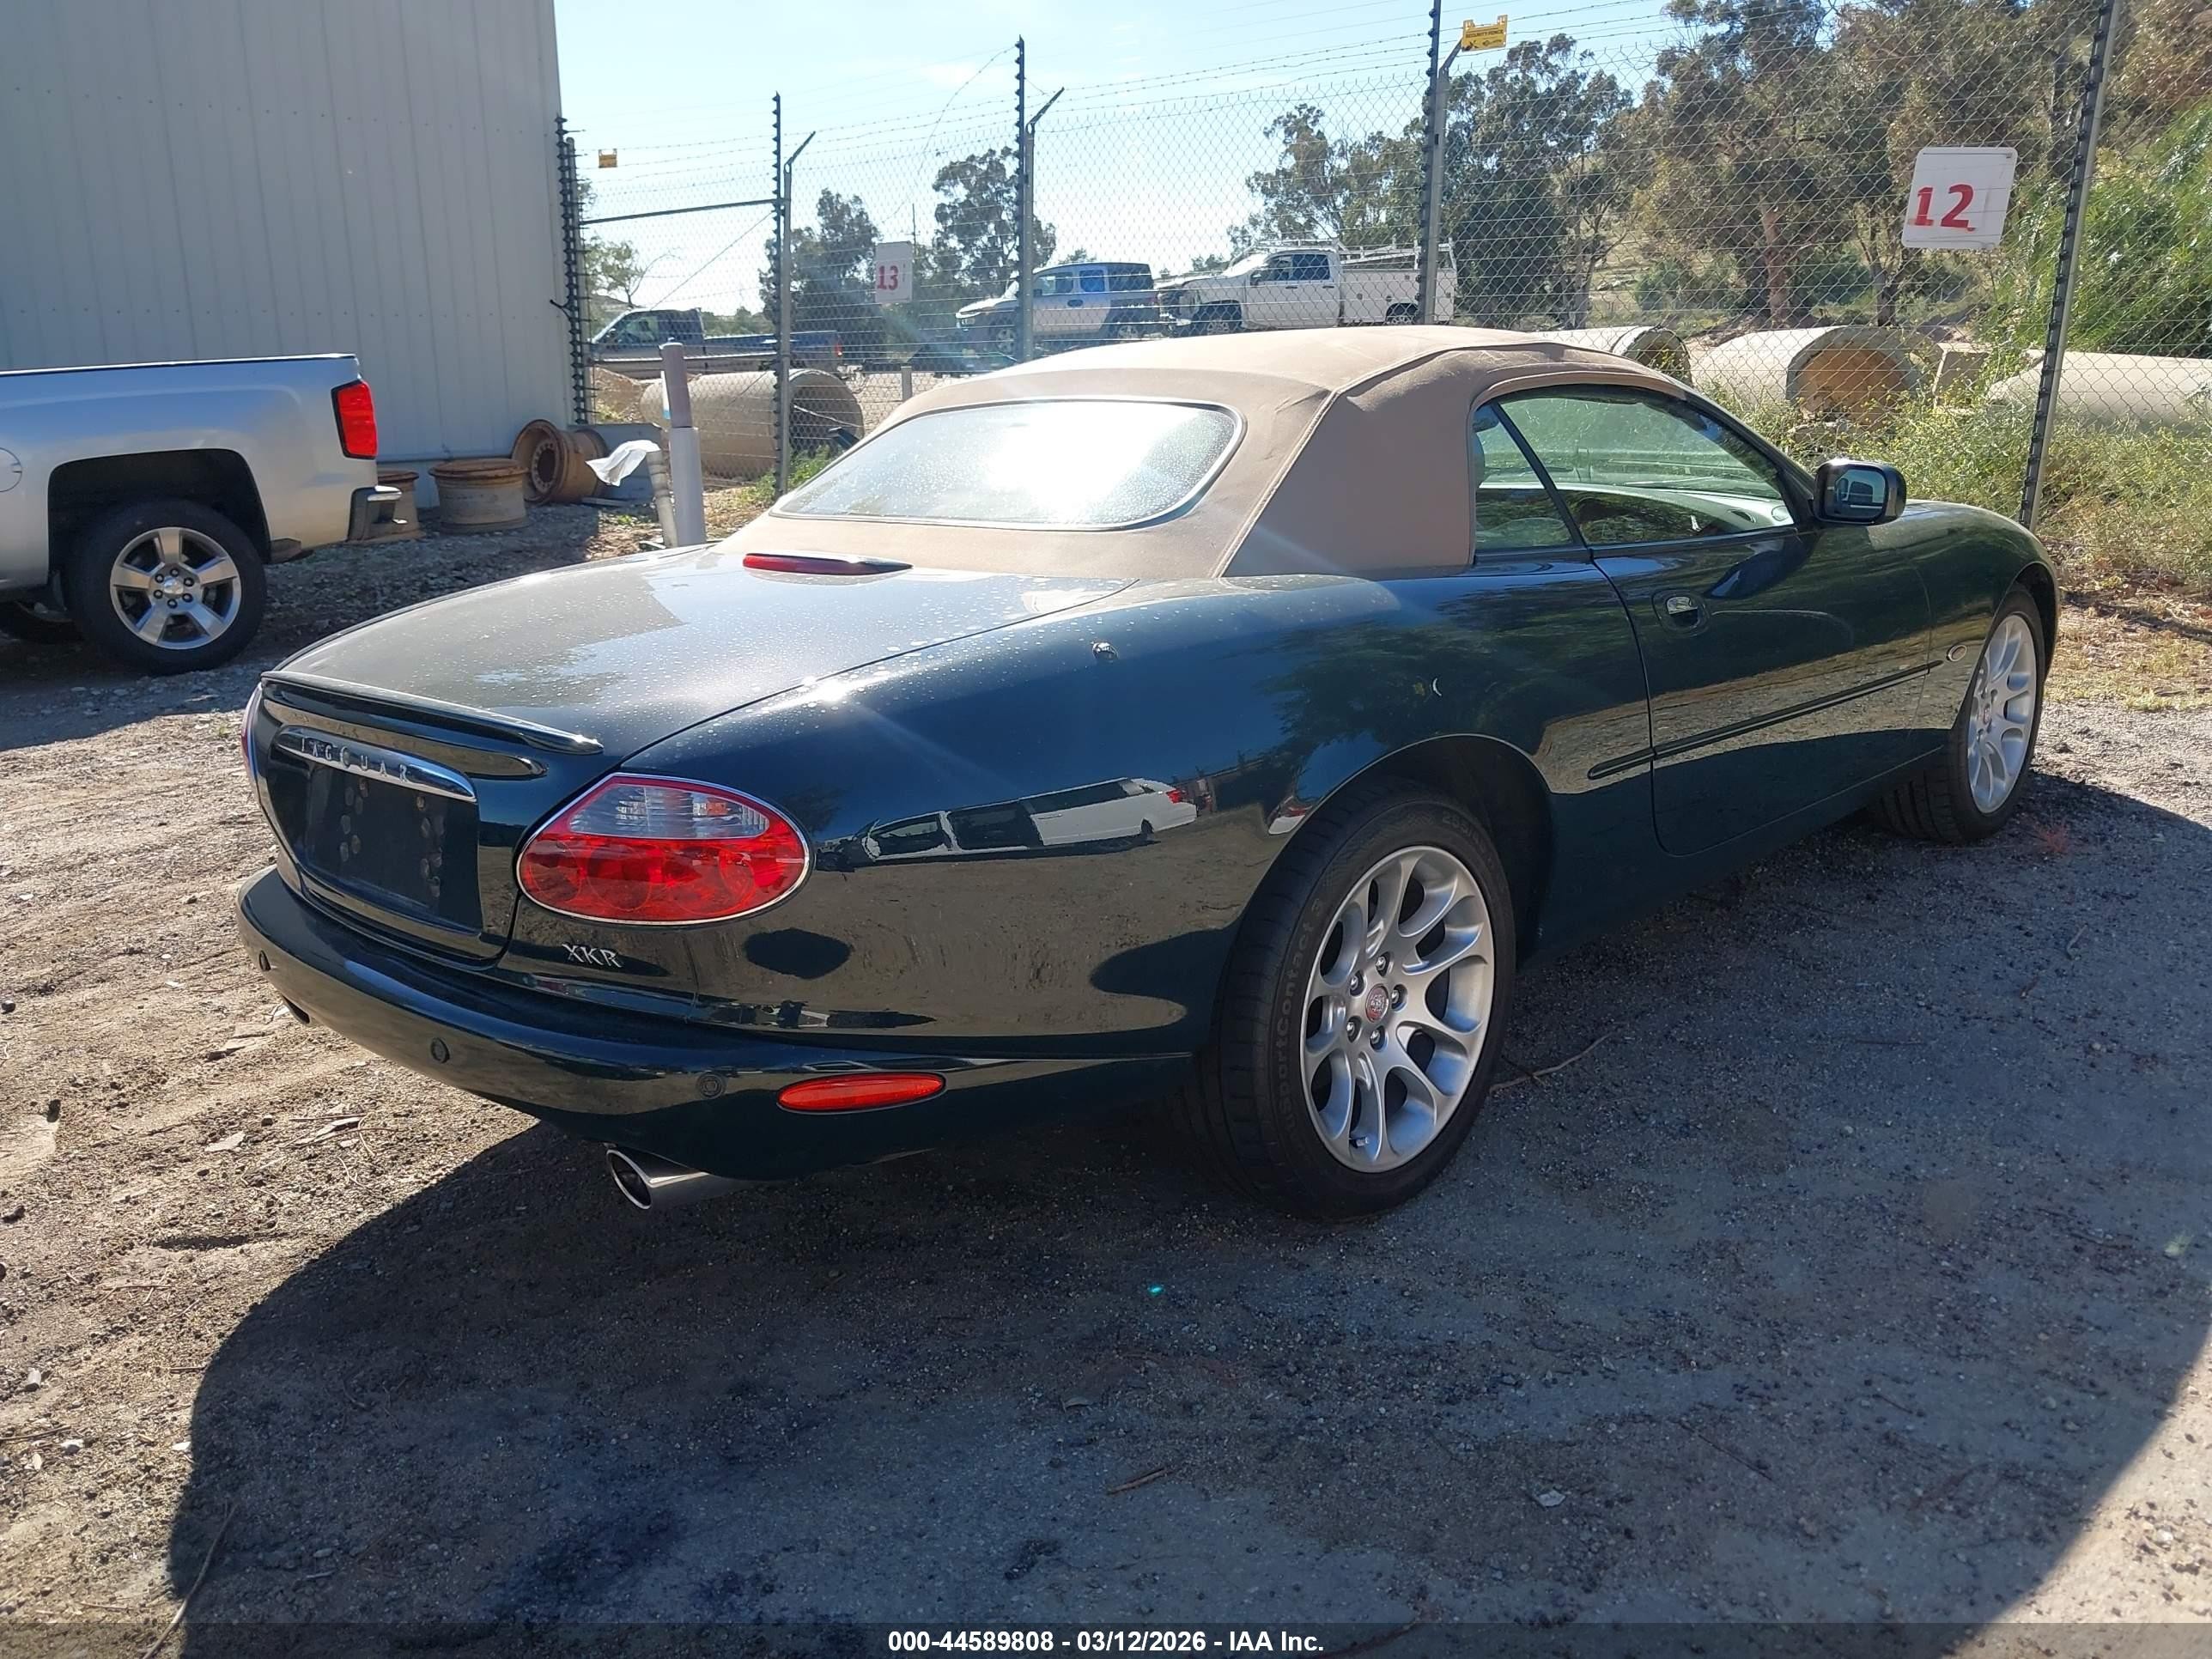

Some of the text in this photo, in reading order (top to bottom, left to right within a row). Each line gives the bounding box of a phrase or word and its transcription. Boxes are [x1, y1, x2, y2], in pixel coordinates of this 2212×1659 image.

[1911, 184, 1974, 228] 12
[877, 264, 900, 291] 13
[301, 737, 410, 783] JAGUAR
[561, 943, 623, 969] XKR
